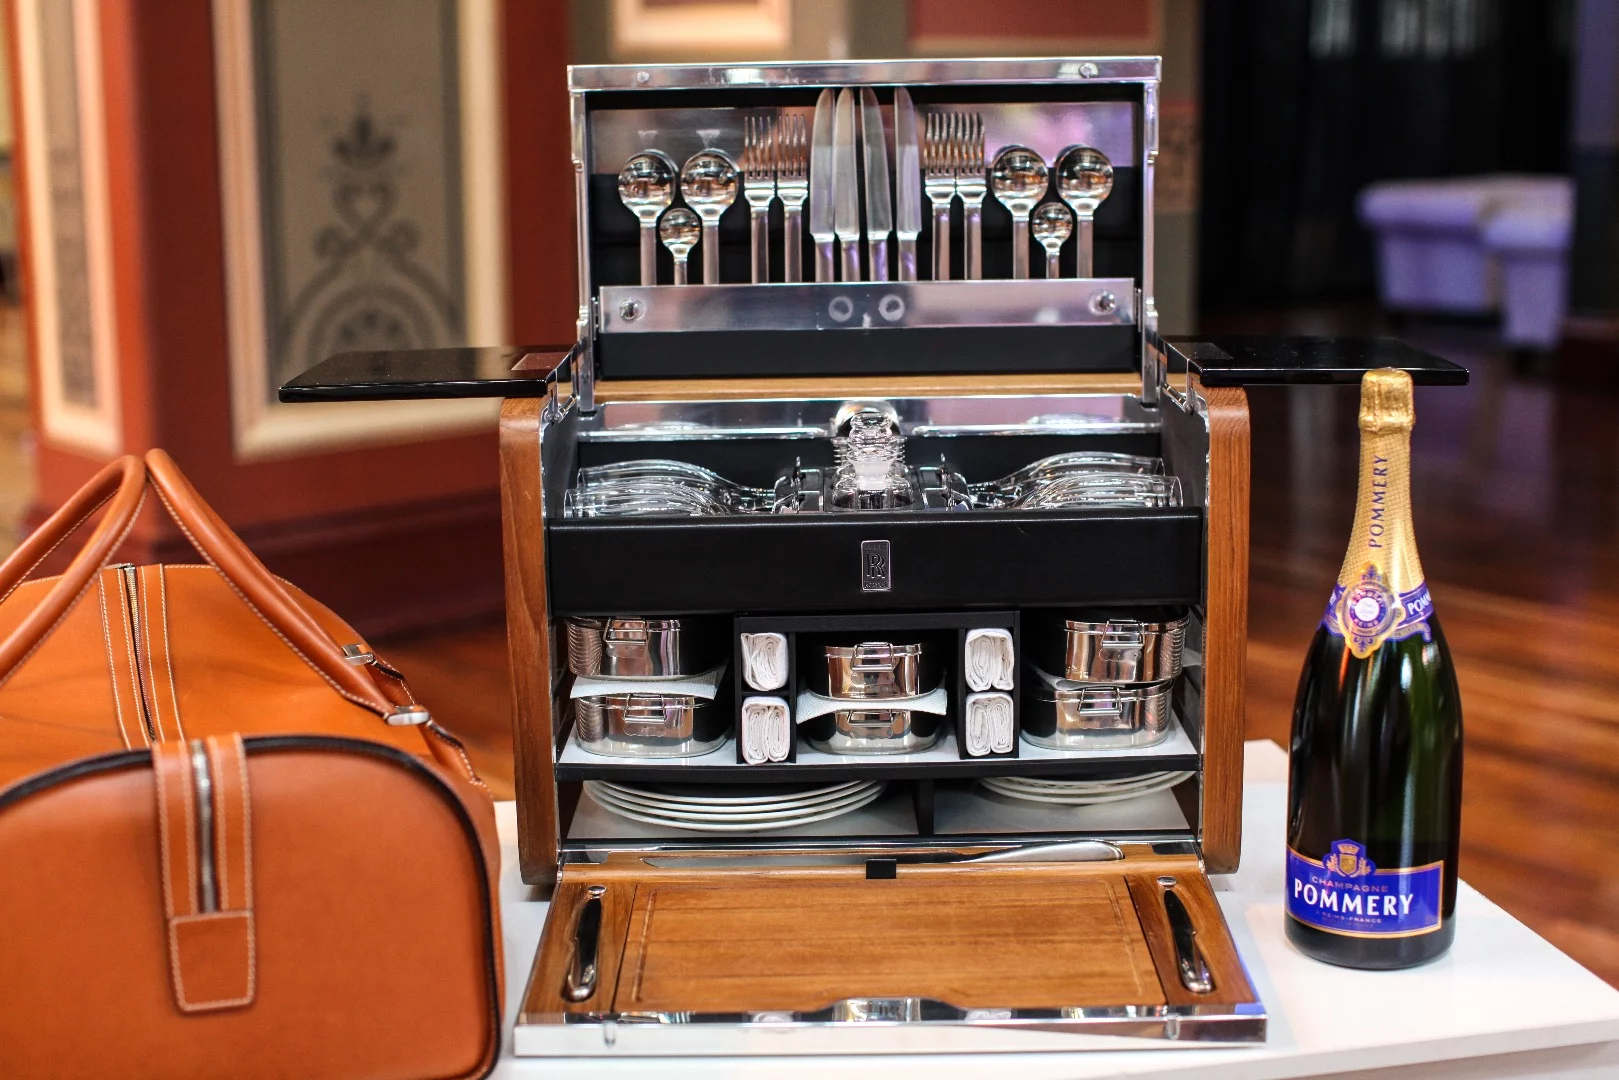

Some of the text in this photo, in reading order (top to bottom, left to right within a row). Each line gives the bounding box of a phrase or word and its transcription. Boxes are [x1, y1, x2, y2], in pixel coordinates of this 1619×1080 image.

[1367, 454, 1388, 549] POMMERY
[1294, 877, 1414, 916] POMMERY
[1311, 875, 1389, 893] CHAMPAGNE
